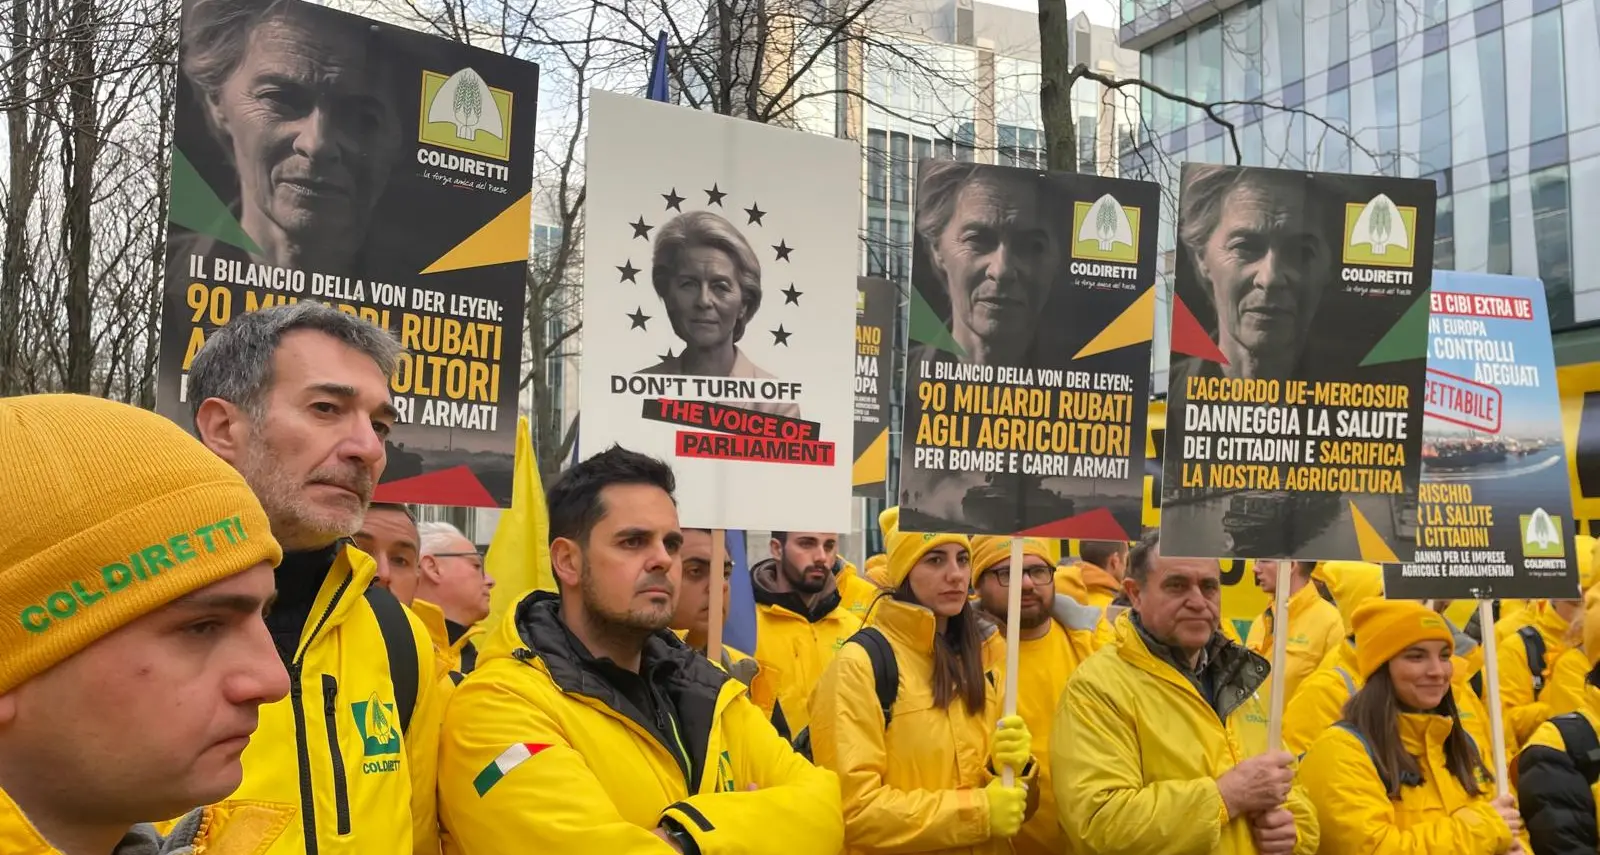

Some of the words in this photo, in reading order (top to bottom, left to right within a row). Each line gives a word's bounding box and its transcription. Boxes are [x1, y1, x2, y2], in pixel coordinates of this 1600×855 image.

[417, 148, 509, 181] COLDIRETTI
[431, 172, 452, 186] forza
[453, 177, 474, 188] amica
[475, 180, 487, 190] del
[1070, 262, 1137, 280] COLDIRETTI
[1341, 267, 1413, 285] COLDIRETTI
[189, 254, 208, 279] IL
[214, 257, 305, 293] BILANCIO
[311, 272, 365, 302] DELLA
[370, 281, 406, 308] VON
[411, 288, 445, 313] DER
[450, 293, 503, 322] LEYEN:
[1429, 293, 1442, 312] EI
[1445, 294, 1472, 314] CIBI
[1474, 296, 1513, 317] EXTRA
[1514, 299, 1531, 318] UE
[186, 282, 232, 326] 90
[400, 312, 502, 361] RUBATI
[856, 325, 881, 345] ANO
[1443, 319, 1487, 337] EUROPA
[1434, 337, 1515, 363] CONTROLLI
[390, 352, 500, 403] OLTORI
[610, 375, 687, 397] DON'T
[692, 379, 755, 399] TURN
[760, 382, 803, 400] OFF
[920, 361, 932, 379] IL
[935, 361, 993, 382] BILANCIO
[997, 366, 1034, 386] DELLA
[1037, 369, 1063, 388] VON
[1066, 371, 1090, 390] DER
[1093, 373, 1133, 392] LEYEN:
[1474, 362, 1540, 388] ADEGUATI
[918, 382, 946, 412] 90
[954, 384, 1050, 419] MILIARDI
[1059, 391, 1133, 424] RUBATI
[1186, 376, 1281, 403] L'ACCORDO
[1285, 380, 1409, 409] UE-MERCOSUR
[1424, 381, 1494, 422] CETTABILE
[420, 399, 498, 432] ARMATI
[658, 399, 704, 424] THE
[708, 408, 777, 438] VOICE
[781, 421, 812, 440] OF
[1185, 404, 1300, 435] DANNEGGIA
[1307, 410, 1330, 437] LA
[1335, 411, 1408, 440] SALUTE
[683, 434, 833, 463] PARLIAMENT
[916, 414, 969, 447] AGLI
[977, 417, 1131, 457] AGRICOLTORI
[914, 447, 945, 470] PER
[949, 450, 1004, 473] BOMBE
[1009, 452, 1018, 474] E
[1022, 453, 1068, 477] CARRI
[1072, 456, 1129, 480] ARMATI
[1183, 436, 1211, 461] DEI
[1216, 438, 1300, 464] CITTADINI
[1304, 441, 1315, 464] E
[1319, 441, 1405, 467] SACRIFICA
[1182, 463, 1204, 489] LA
[1209, 464, 1280, 491] NOSTRA
[1284, 467, 1404, 494] AGRICOLTURA
[1418, 483, 1472, 503] RISCHIO
[1426, 505, 1444, 526] LA
[1445, 505, 1494, 526] SALUTE
[1424, 526, 1489, 547] CITTADINI
[1402, 564, 1441, 577] AGRICOLE
[1441, 565, 1448, 577] E
[1448, 565, 1514, 577] AGROALIMENTARI
[1414, 550, 1442, 563] DANNO
[1443, 551, 1459, 563] PER
[1461, 551, 1471, 563] LE
[1472, 551, 1506, 563] IMPRESE
[1524, 558, 1566, 569] COLDIRETTI
[20, 515, 248, 635] COLDIRETTI
